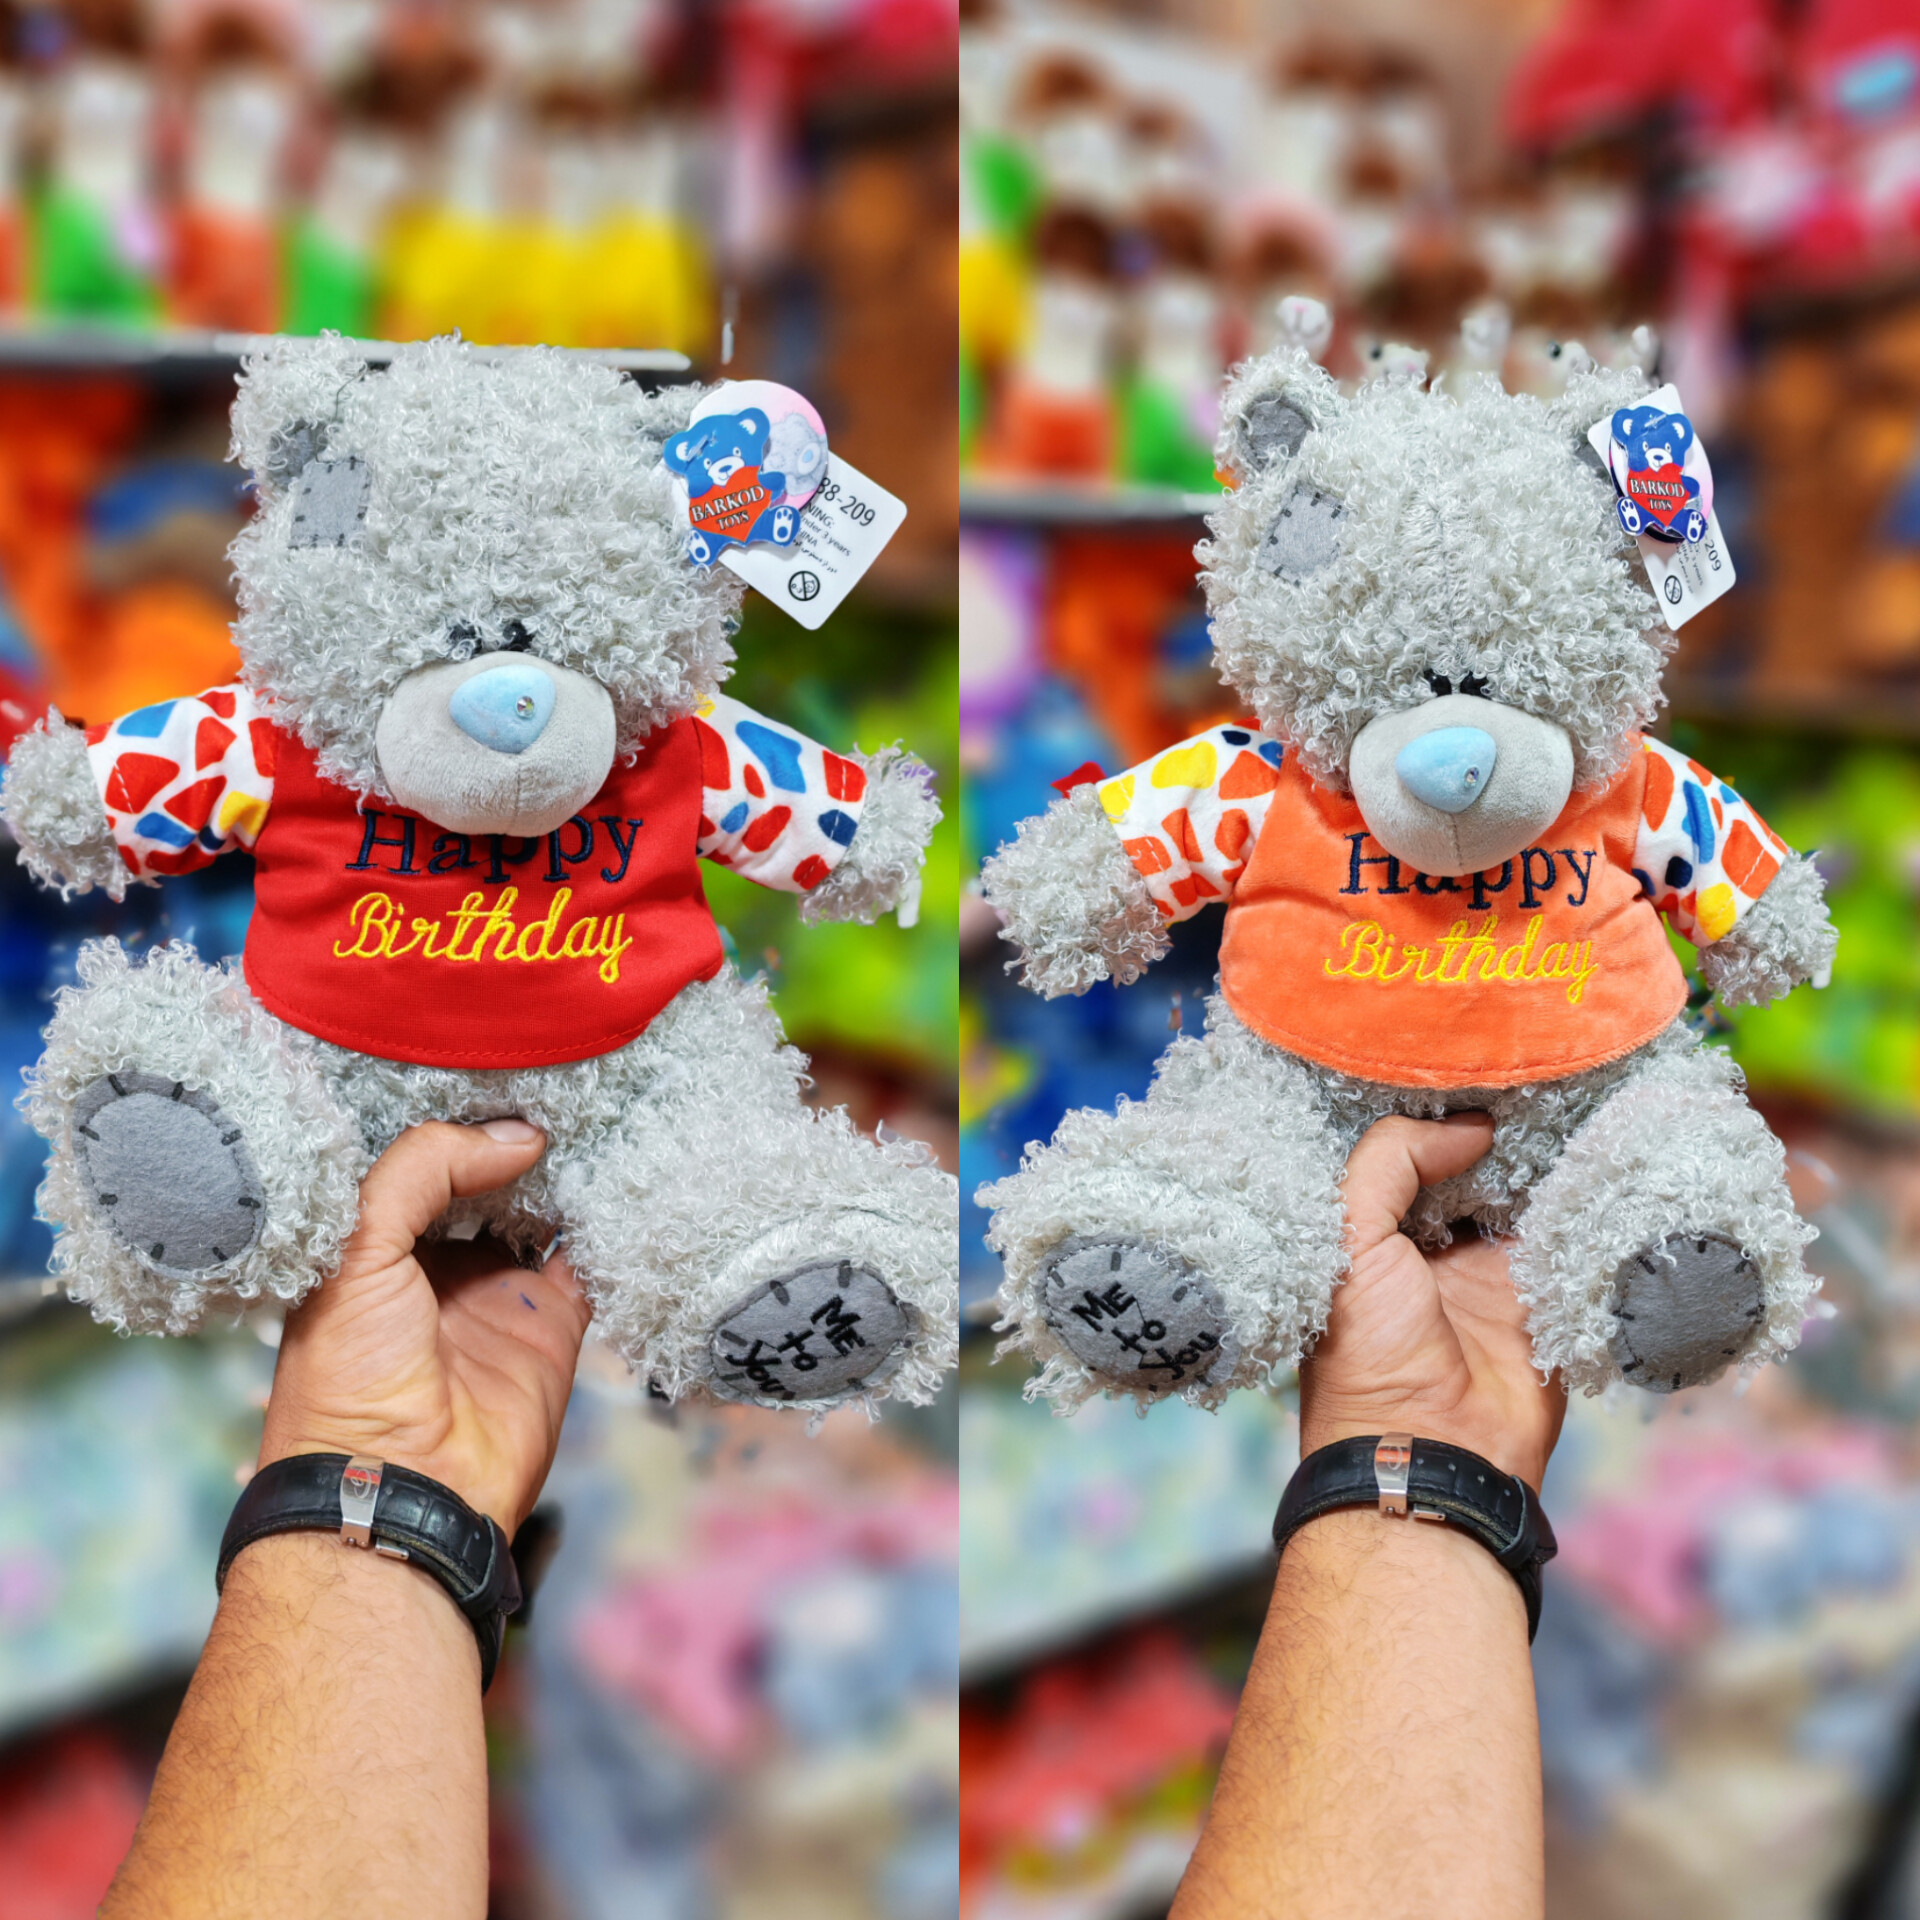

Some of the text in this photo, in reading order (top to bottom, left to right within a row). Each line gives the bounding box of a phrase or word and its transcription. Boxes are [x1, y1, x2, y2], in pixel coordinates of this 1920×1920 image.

[690, 485, 766, 523] BARKOD
[1629, 478, 1686, 498] BARKOD
[1648, 498, 1673, 511] TOYS
[716, 510, 750, 531] TOYS
[803, 502, 835, 529] NING:
[827, 537, 851, 557] years
[345, 808, 643, 884] Happy
[333, 886, 633, 984] Birthday
[1324, 914, 1599, 1004] Birthday
[776, 1329, 819, 1371] to
[1112, 1319, 1167, 1354] to
